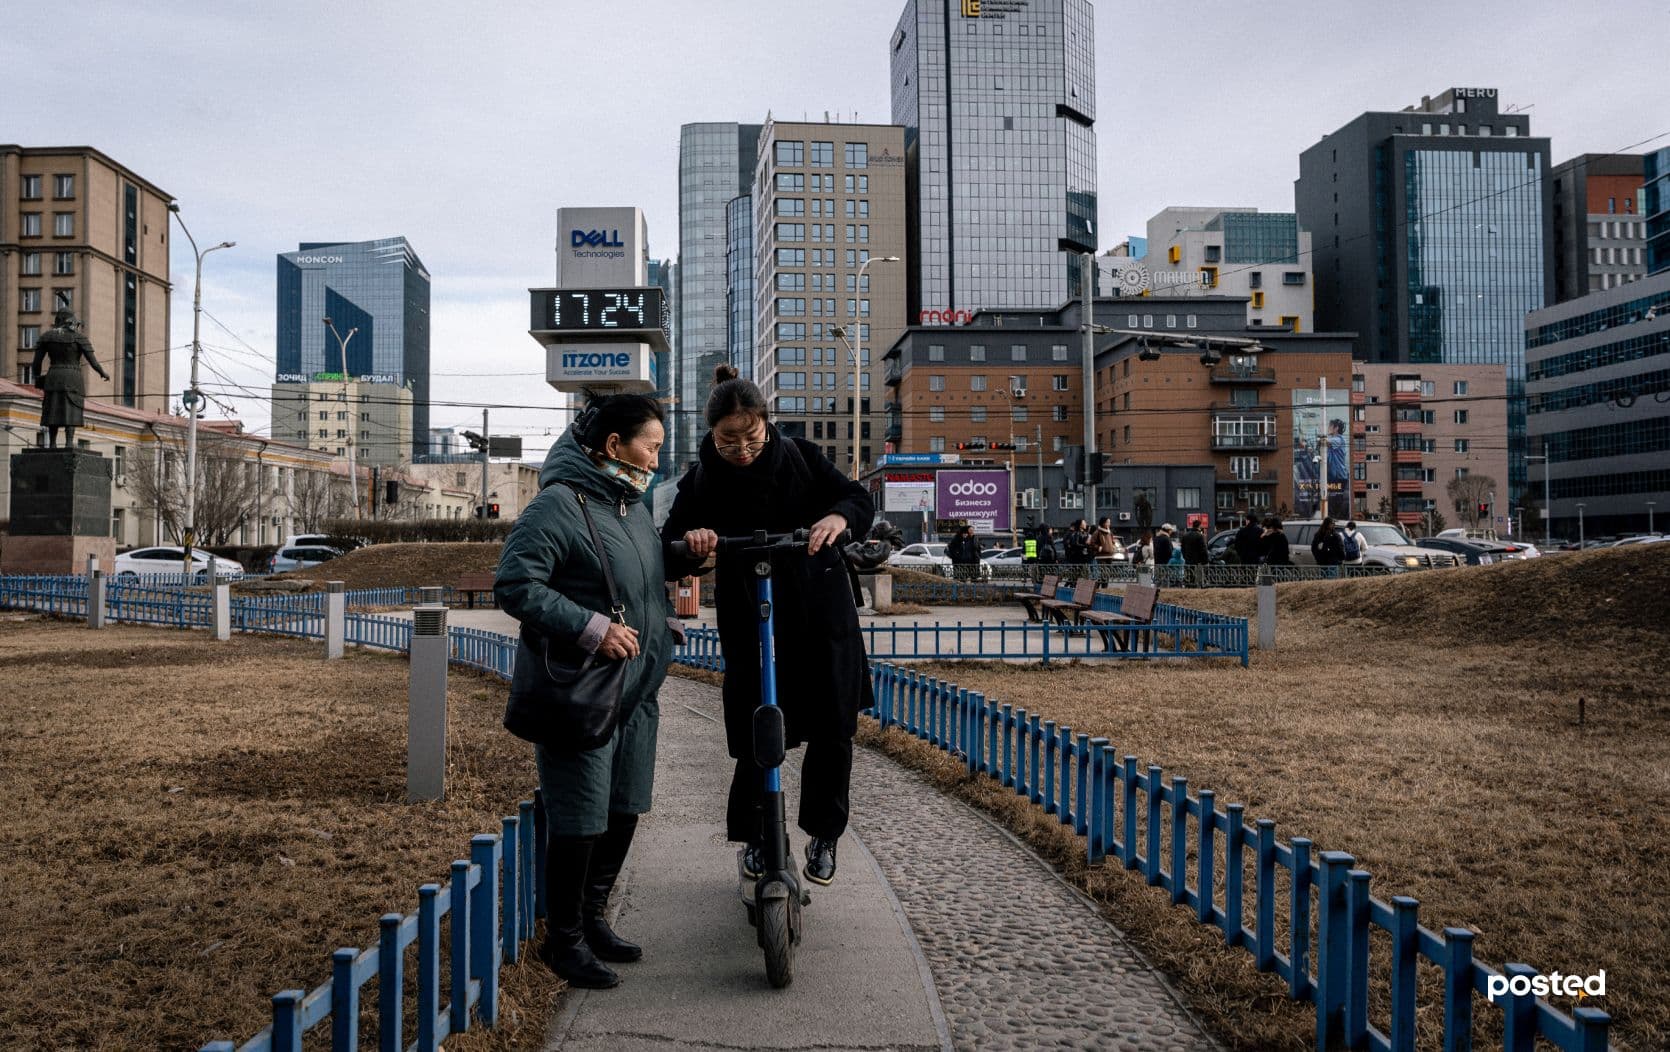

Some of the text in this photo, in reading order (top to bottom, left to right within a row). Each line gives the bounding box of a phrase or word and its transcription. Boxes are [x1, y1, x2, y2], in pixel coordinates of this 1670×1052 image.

[1455, 88, 1495, 97] MERU
[572, 229, 624, 247] DELL
[572, 249, 625, 259] Technologies
[278, 374, 307, 382] ЗОЧИД
[949, 479, 997, 495] odoo
